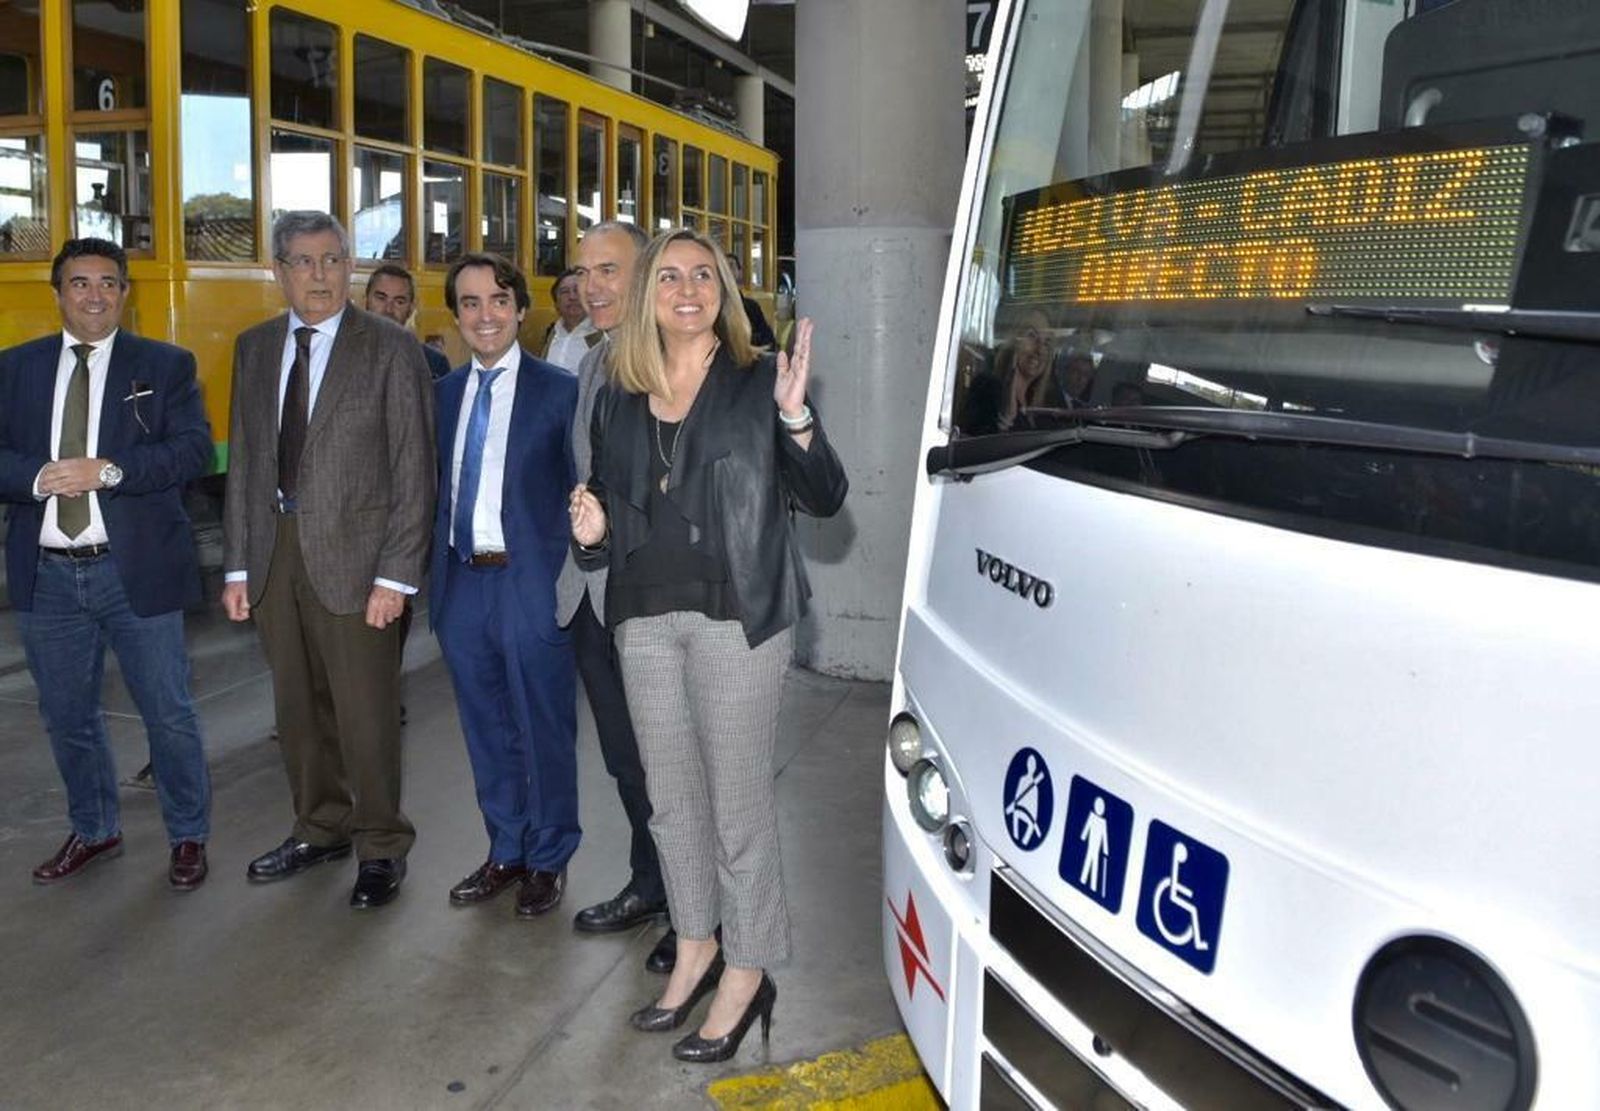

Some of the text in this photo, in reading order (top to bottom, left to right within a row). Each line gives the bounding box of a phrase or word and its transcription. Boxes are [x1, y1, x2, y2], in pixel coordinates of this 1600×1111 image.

[99, 79, 114, 111] 6
[1239, 151, 1482, 230] CADIZ
[1077, 238, 1314, 301] DIRECTO
[975, 547, 1055, 609] VOLVO
